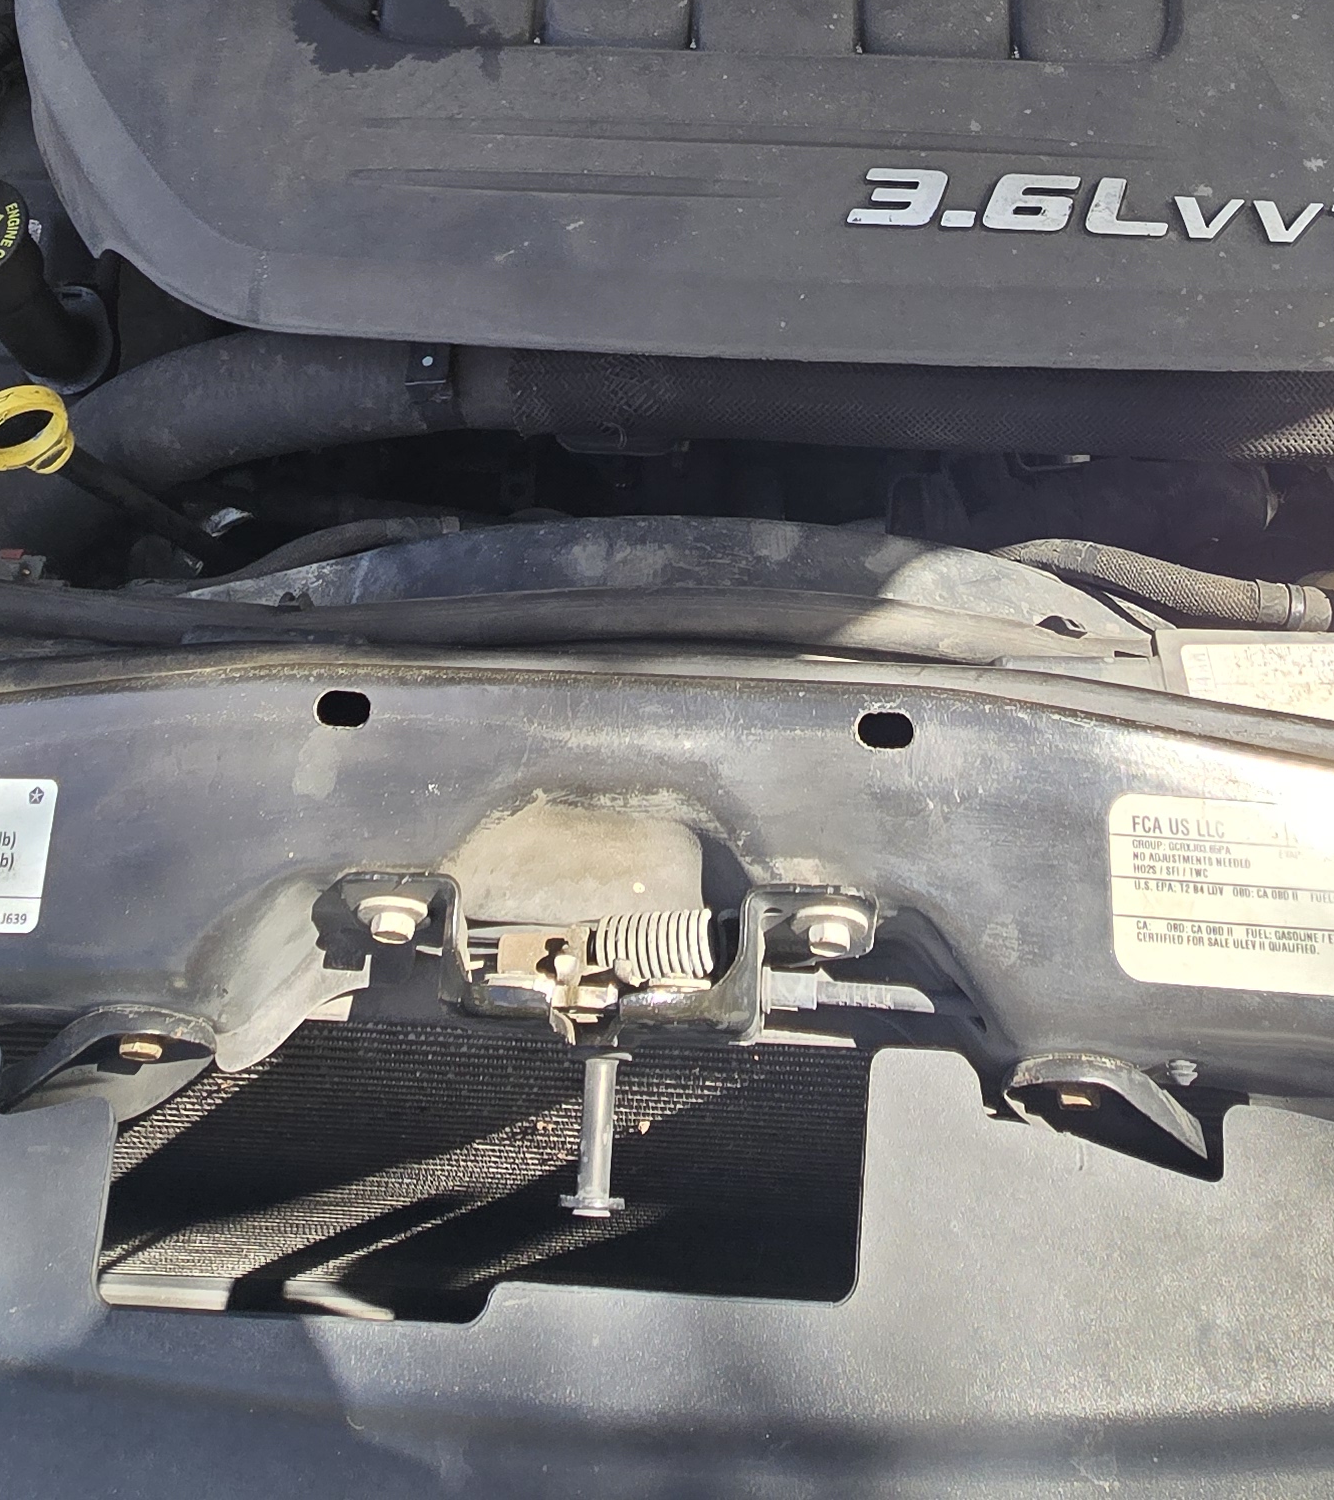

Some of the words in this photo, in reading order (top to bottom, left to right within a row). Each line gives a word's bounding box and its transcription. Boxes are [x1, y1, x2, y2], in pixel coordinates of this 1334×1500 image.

[846, 167, 1169, 236] 3.6L
[4, 202, 21, 248] ENGINE
[1132, 815, 1163, 835] FCA
[1168, 817, 1190, 836] US
[1196, 819, 1225, 839] LLC
[1132, 839, 1167, 851] GROUP:
[1132, 852, 1146, 862] NO
[1149, 852, 1214, 867] ADJUSTMENTS
[1216, 857, 1251, 870] NEEDED
[1133, 863, 1157, 875] HO2S
[1166, 865, 1180, 877] SFI
[1189, 866, 1209, 879] TWC
[1134, 879, 1154, 892] U.S.
[1155, 881, 1177, 893] EPA:
[1180, 882, 1191, 894] T2
[1193, 883, 1205, 895] B4
[1207, 884, 1224, 896] LDV
[1232, 886, 1255, 899] OBD:
[1256, 888, 1269, 899] CA
[1271, 889, 1290, 901] OBD
[1291, 890, 1299, 902] II
[0, 912, 27, 926] J639
[1136, 919, 1152, 932] CA:
[1166, 922, 1189, 934] OBD:
[1190, 924, 1203, 935] CA
[1205, 925, 1224, 937] OBD
[1245, 927, 1272, 940] FUEL:
[1274, 930, 1319, 943] GASOLINE
[1136, 931, 1184, 945] CERTIFIED
[1186, 934, 1205, 947] FOR
[1207, 935, 1230, 949] SALE
[1232, 937, 1257, 951] ULEV
[1258, 939, 1266, 951] II
[1268, 941, 1320, 955] QUALIFIED.
